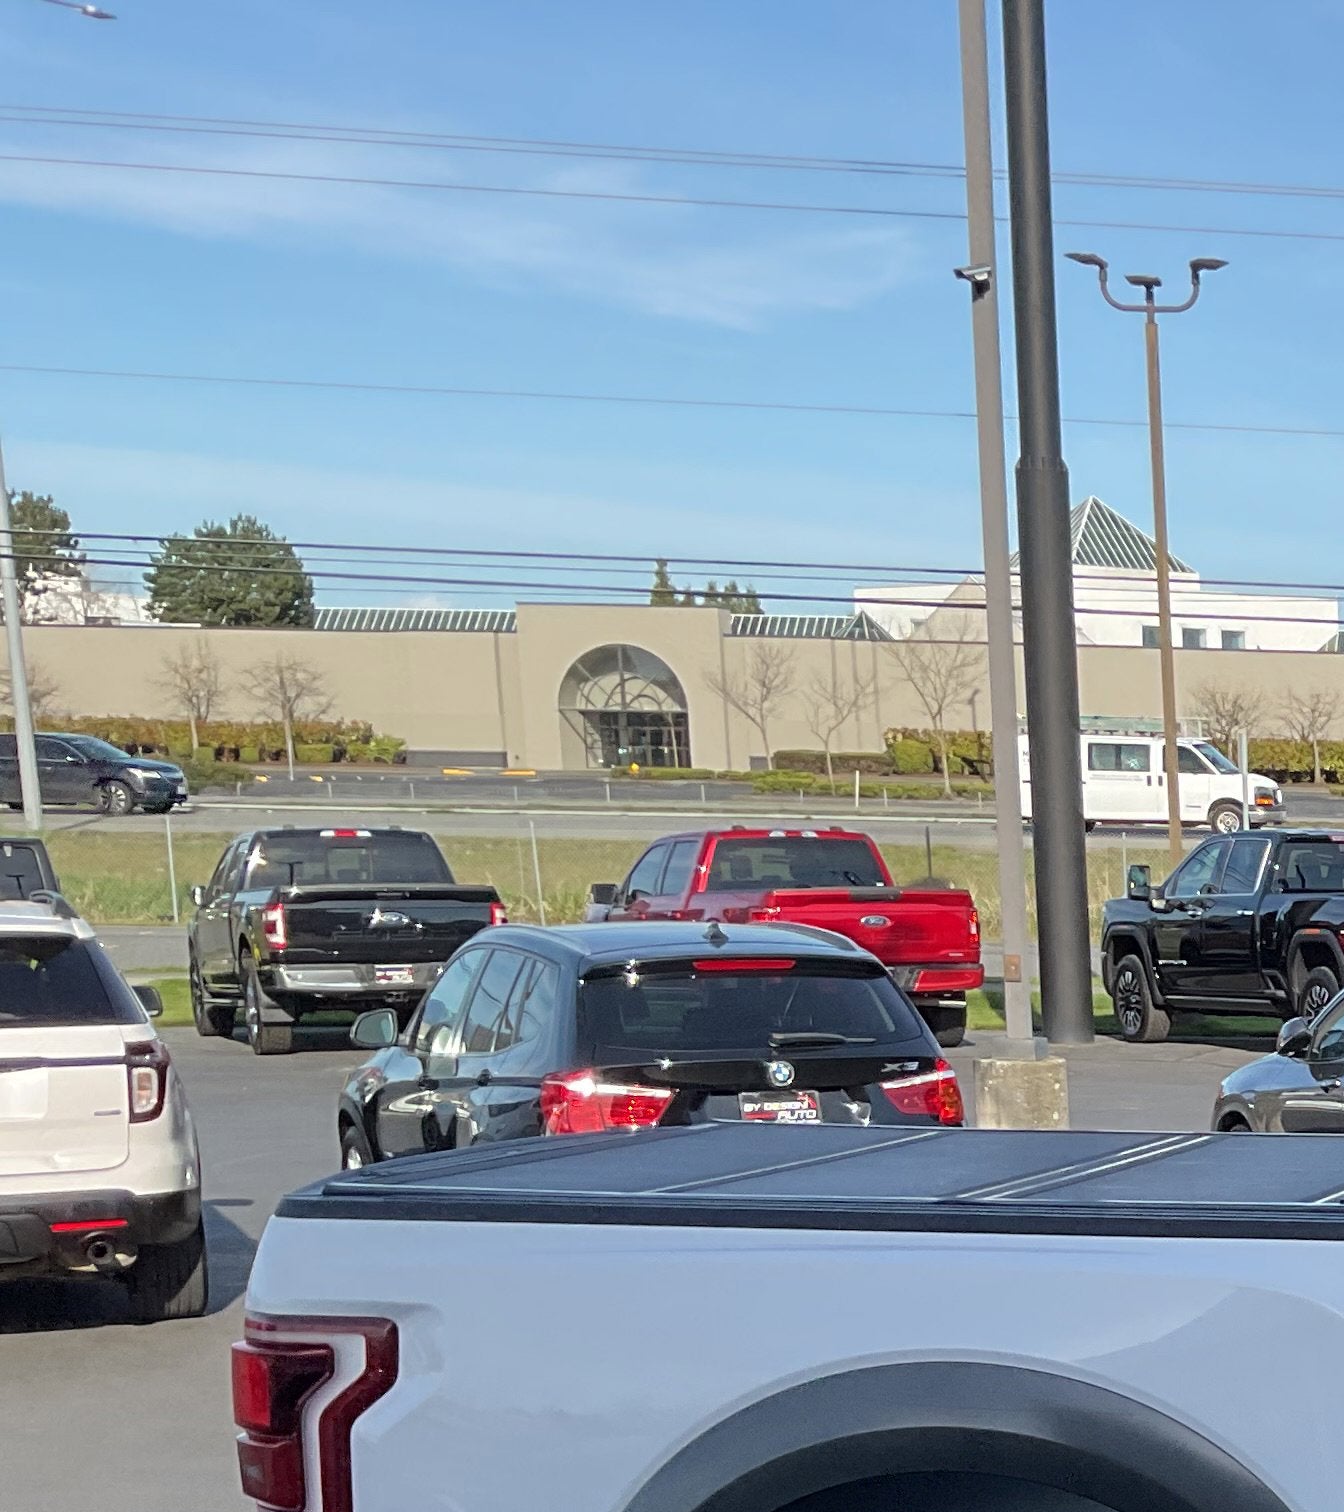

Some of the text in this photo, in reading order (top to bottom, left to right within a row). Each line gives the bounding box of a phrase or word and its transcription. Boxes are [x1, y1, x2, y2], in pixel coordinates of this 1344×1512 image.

[744, 1101, 808, 1112] BY DESIGN
[777, 1110, 816, 1120] AUTO
